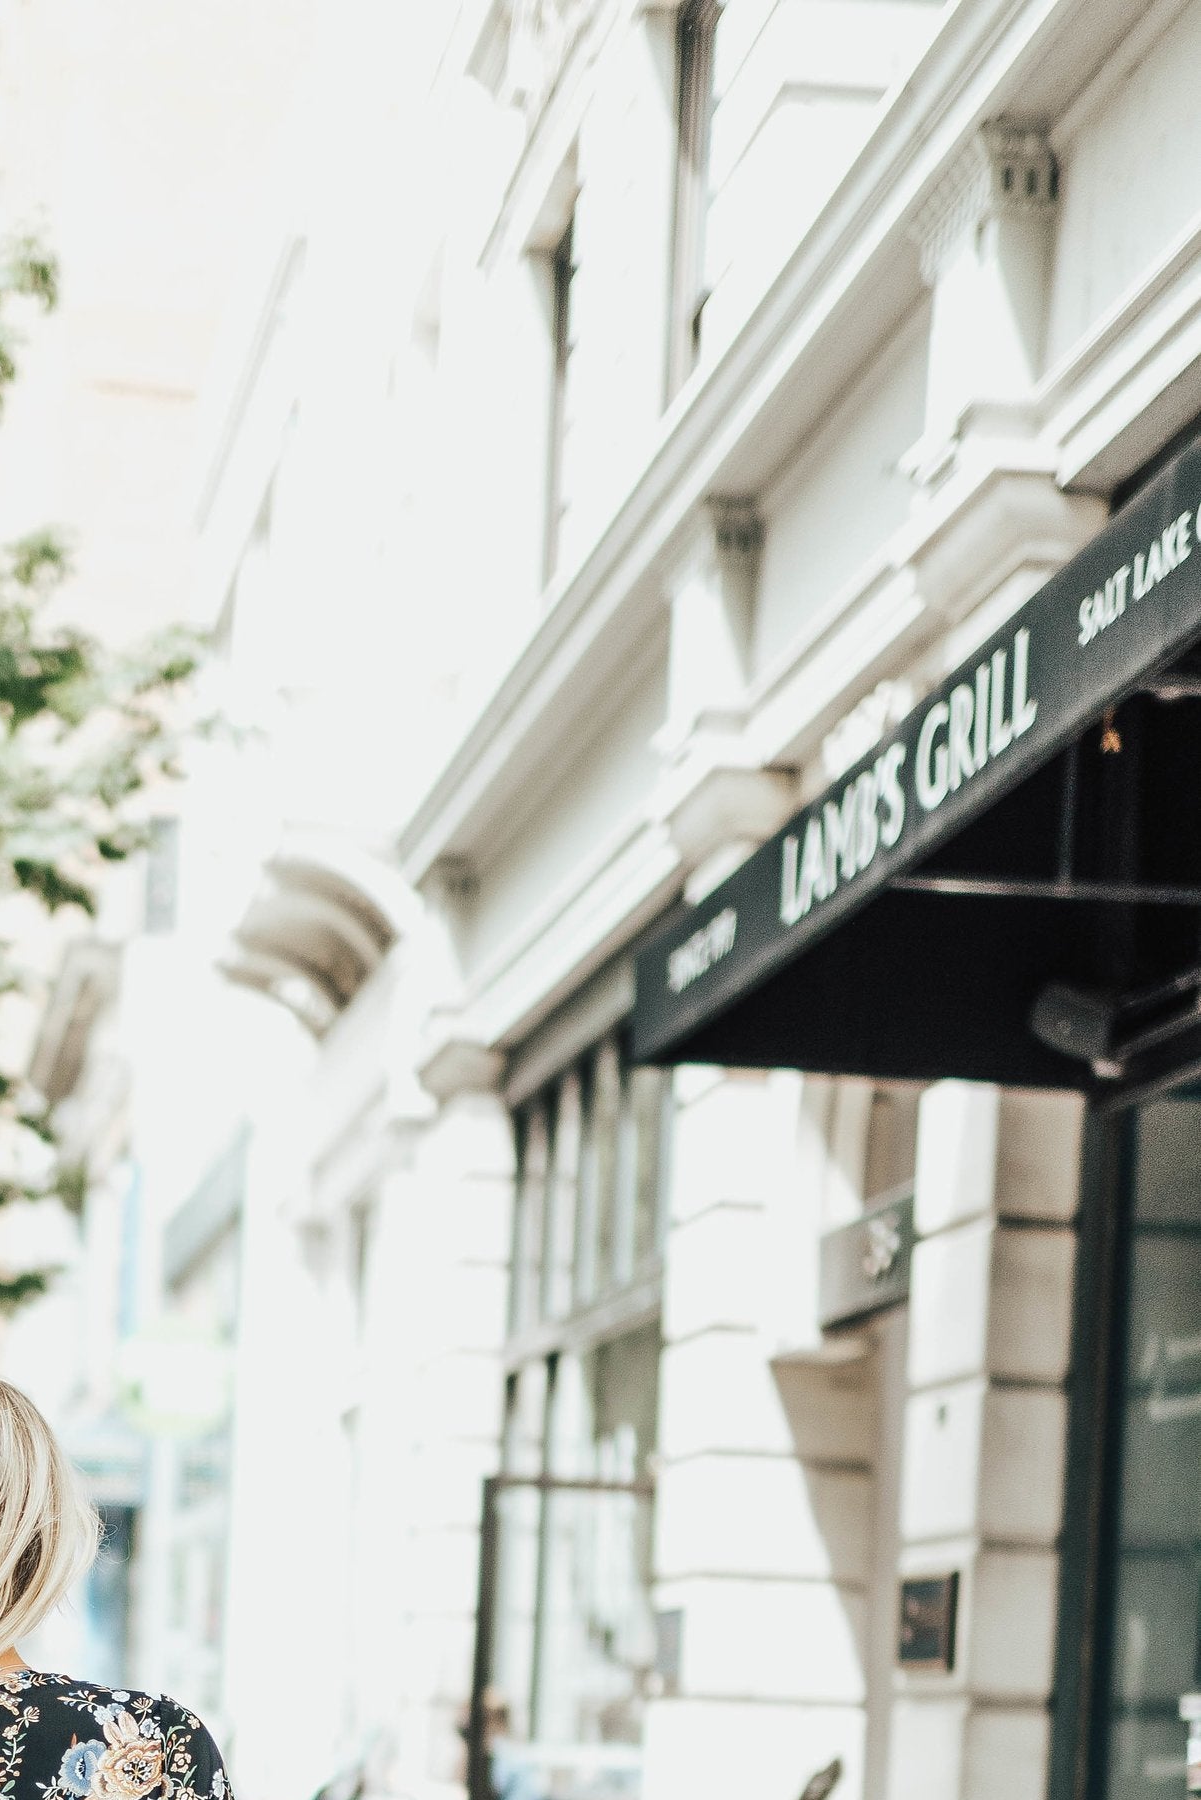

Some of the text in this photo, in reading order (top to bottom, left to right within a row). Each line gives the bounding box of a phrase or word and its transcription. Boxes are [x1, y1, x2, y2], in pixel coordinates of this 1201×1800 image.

[1078, 563, 1132, 647] SALT
[1132, 509, 1193, 601] LAKE
[780, 627, 1038, 926] LAMB'S GRILL
